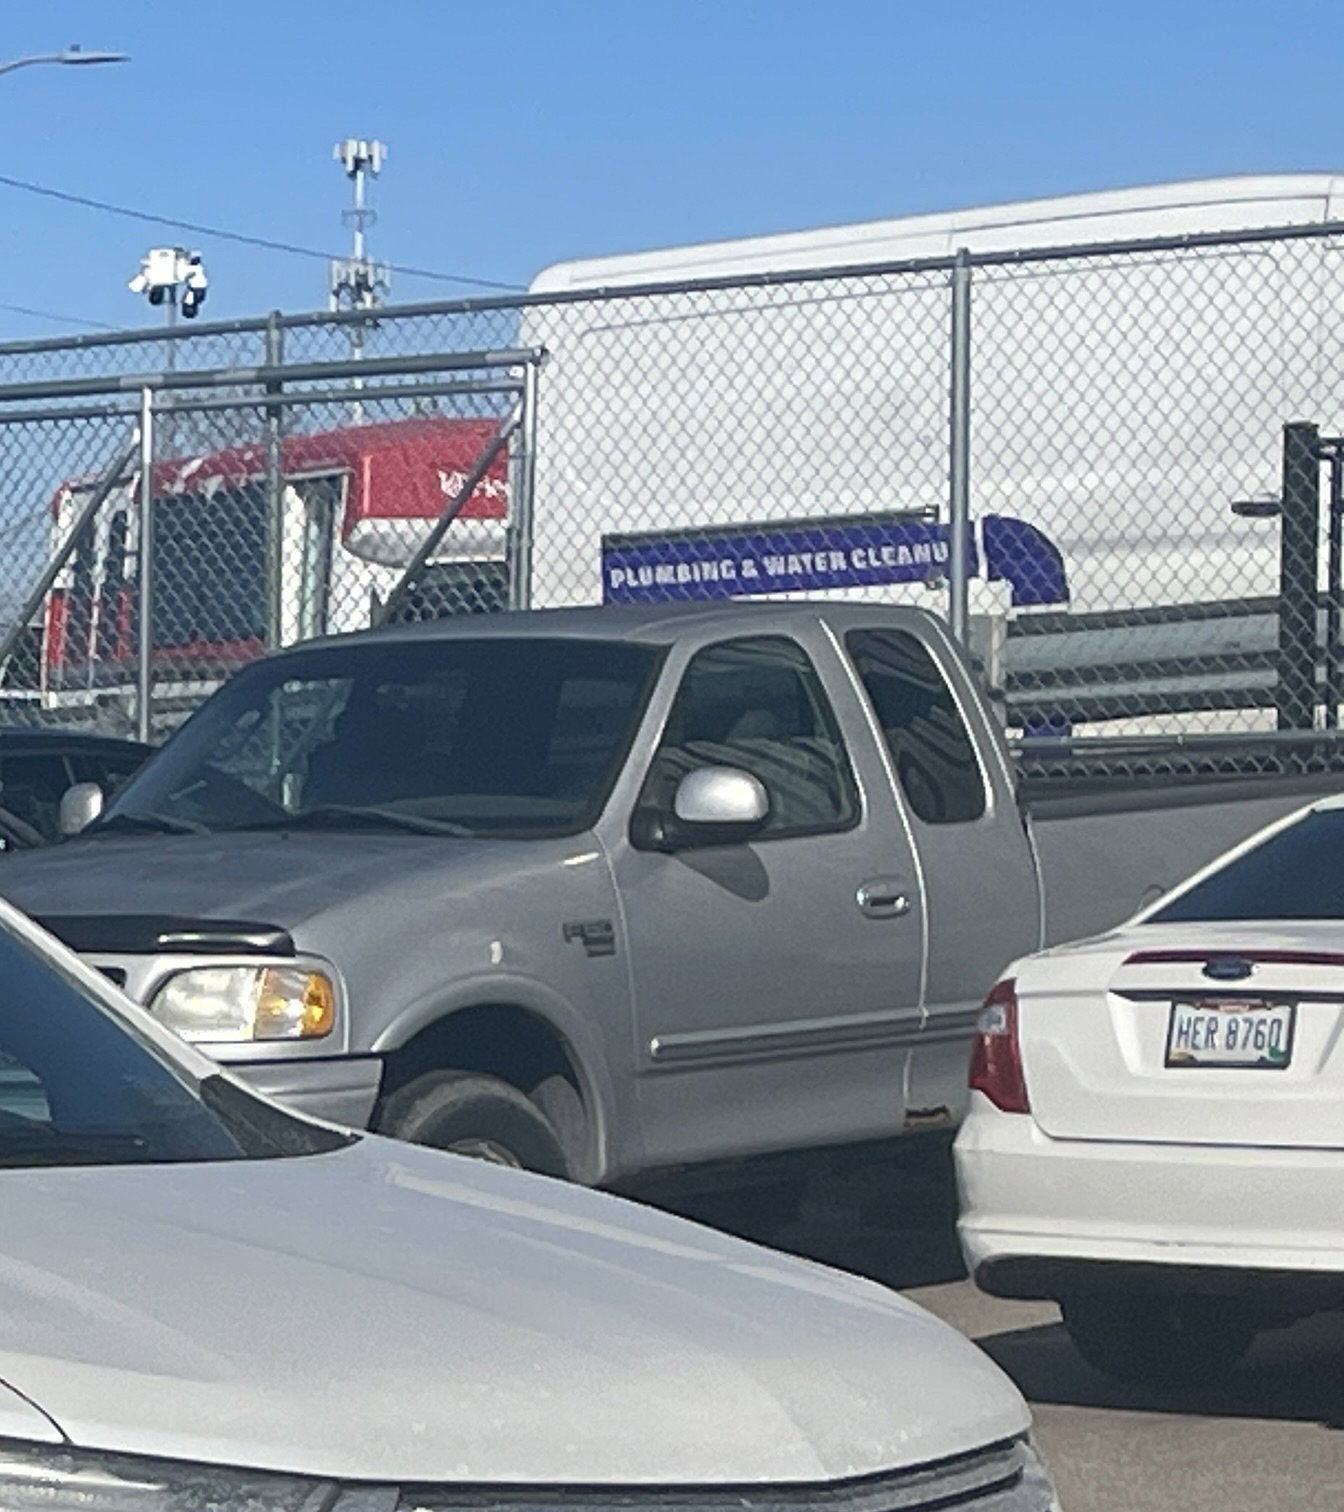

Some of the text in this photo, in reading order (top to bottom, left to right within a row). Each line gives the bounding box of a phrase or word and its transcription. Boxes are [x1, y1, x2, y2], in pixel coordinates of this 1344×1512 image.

[610, 541, 949, 589] PLUMBING & WATER CLEANU
[1176, 1015, 1283, 1051] HER 8760
